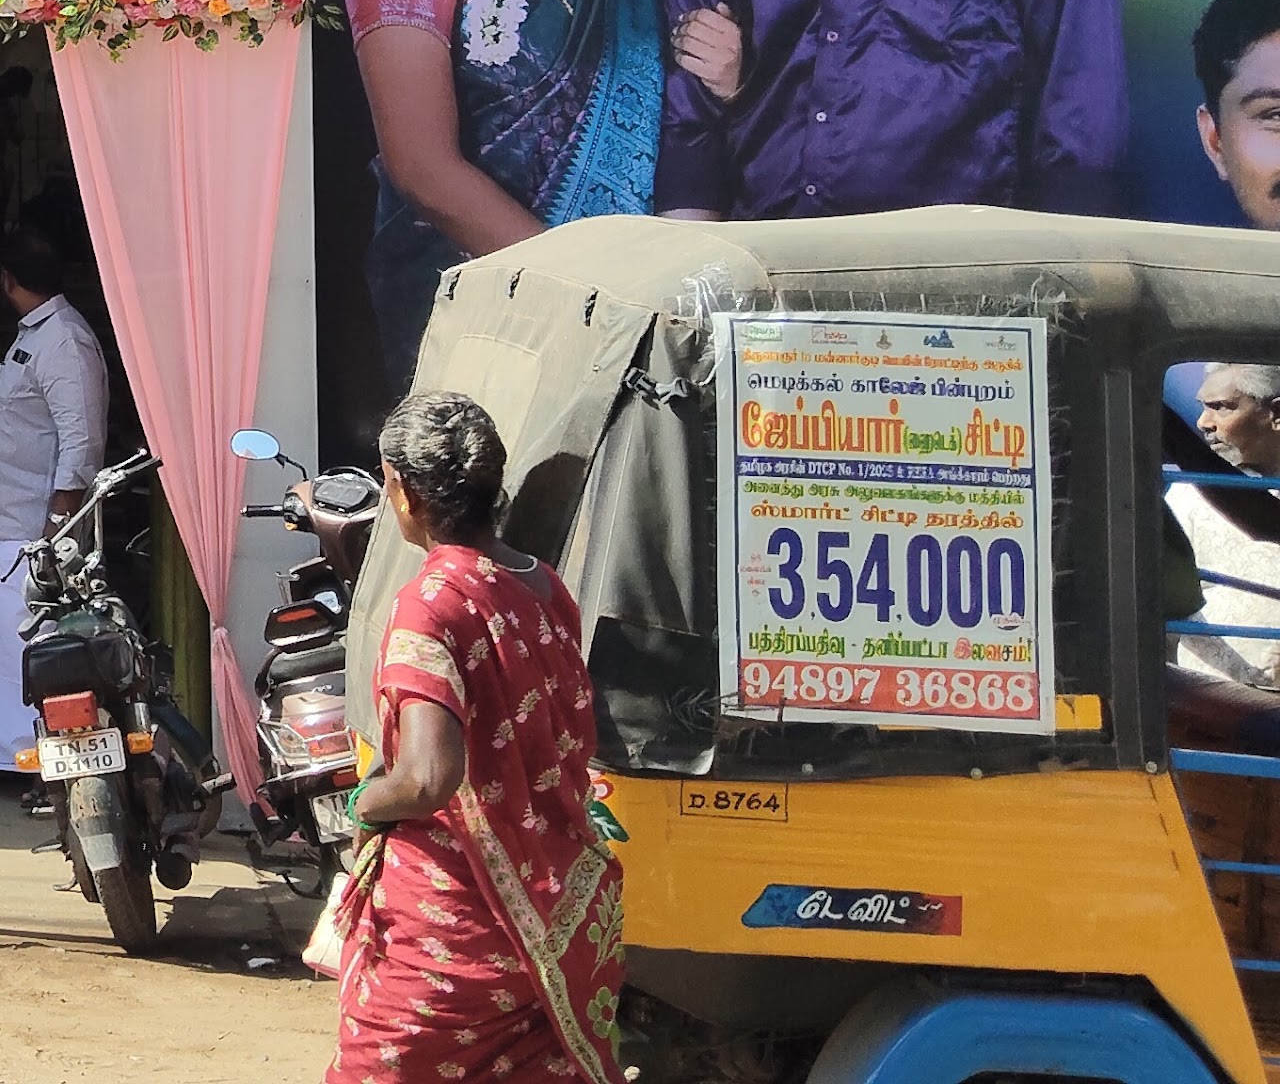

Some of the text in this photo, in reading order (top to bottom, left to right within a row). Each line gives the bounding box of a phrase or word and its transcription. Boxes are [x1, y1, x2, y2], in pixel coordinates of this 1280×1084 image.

[747, 370, 1015, 402] மெடிக்கல் காலேஜ் பின்புறம்
[742, 395, 905, 454] ஜேப்பியார்
[964, 407, 1025, 469] சிட்டி
[808, 461, 836, 476] DTCP
[751, 499, 1024, 530] ஸ்மார்ட் சிட்டி தரத்தில்
[743, 662, 1035, 712] 94897 36868
